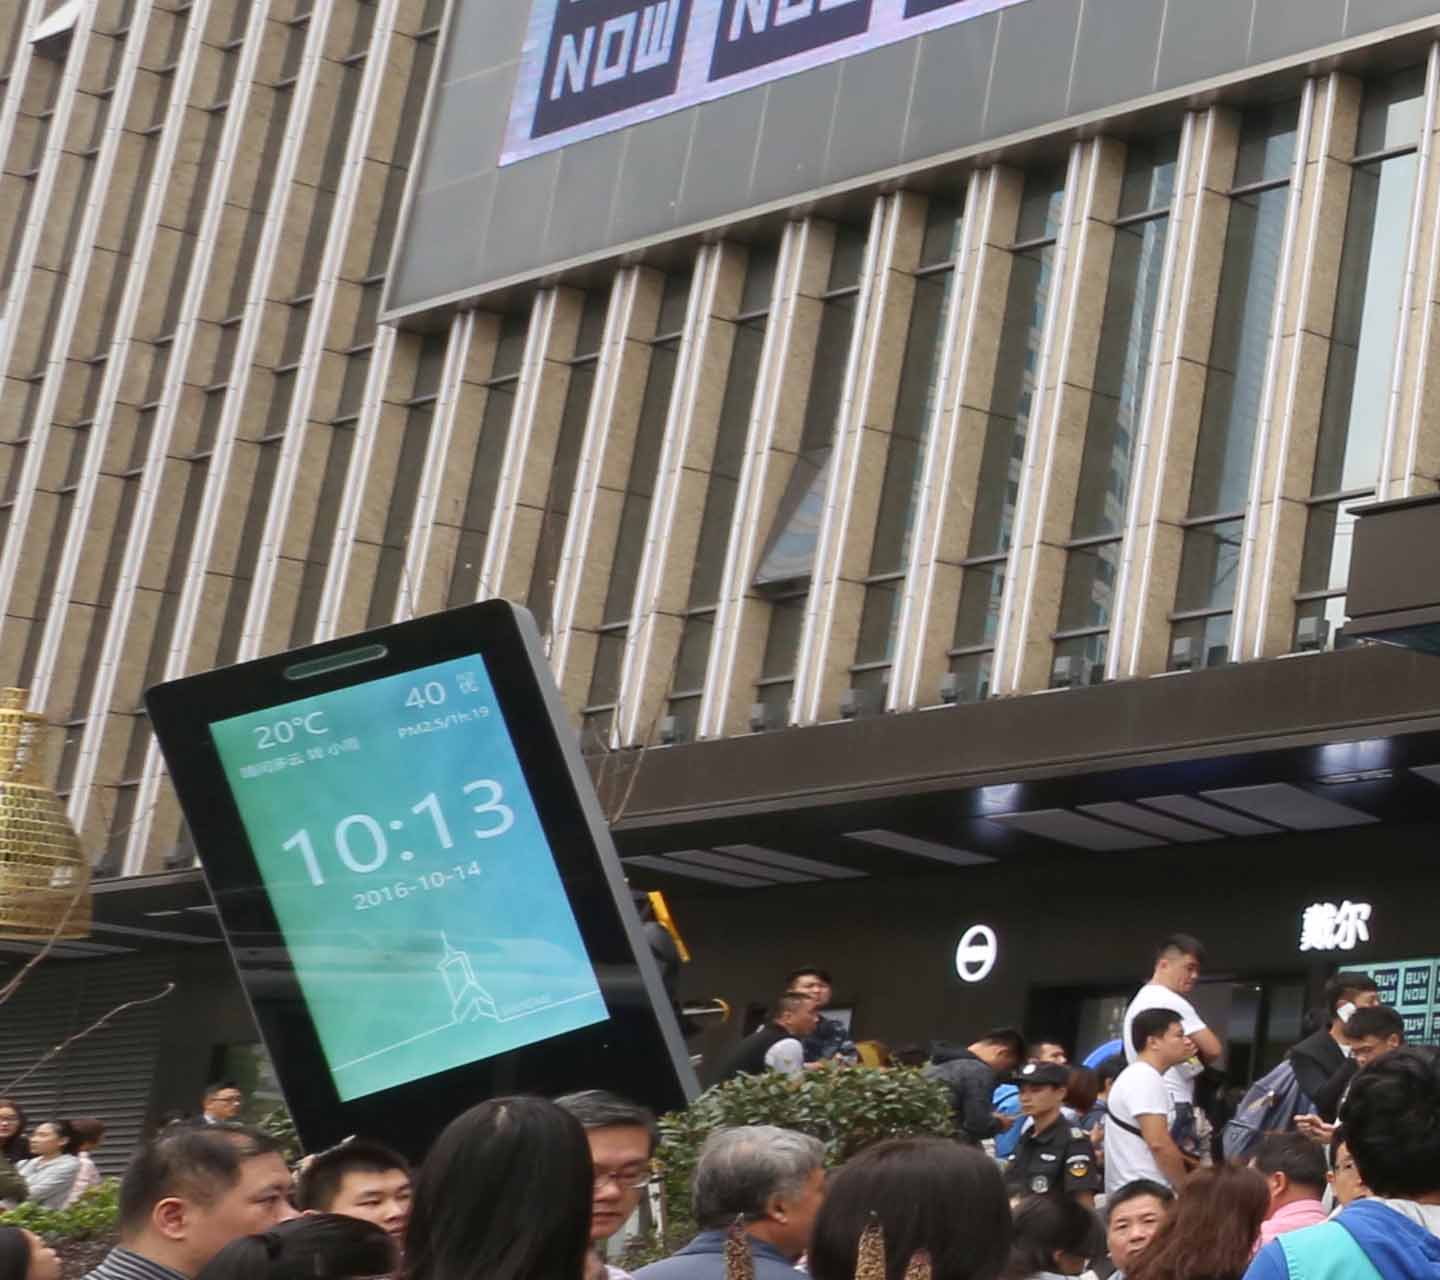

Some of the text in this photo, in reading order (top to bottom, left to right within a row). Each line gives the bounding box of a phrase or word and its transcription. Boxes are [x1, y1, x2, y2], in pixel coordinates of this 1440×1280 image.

[404, 681, 446, 709] 40
[282, 778, 515, 887] 10:13
[352, 860, 482, 911] 2016-10-14
[1300, 900, 1372, 951] 戴尔
[1404, 987, 1427, 1001] NOW
[1405, 970, 1429, 985] BUY
